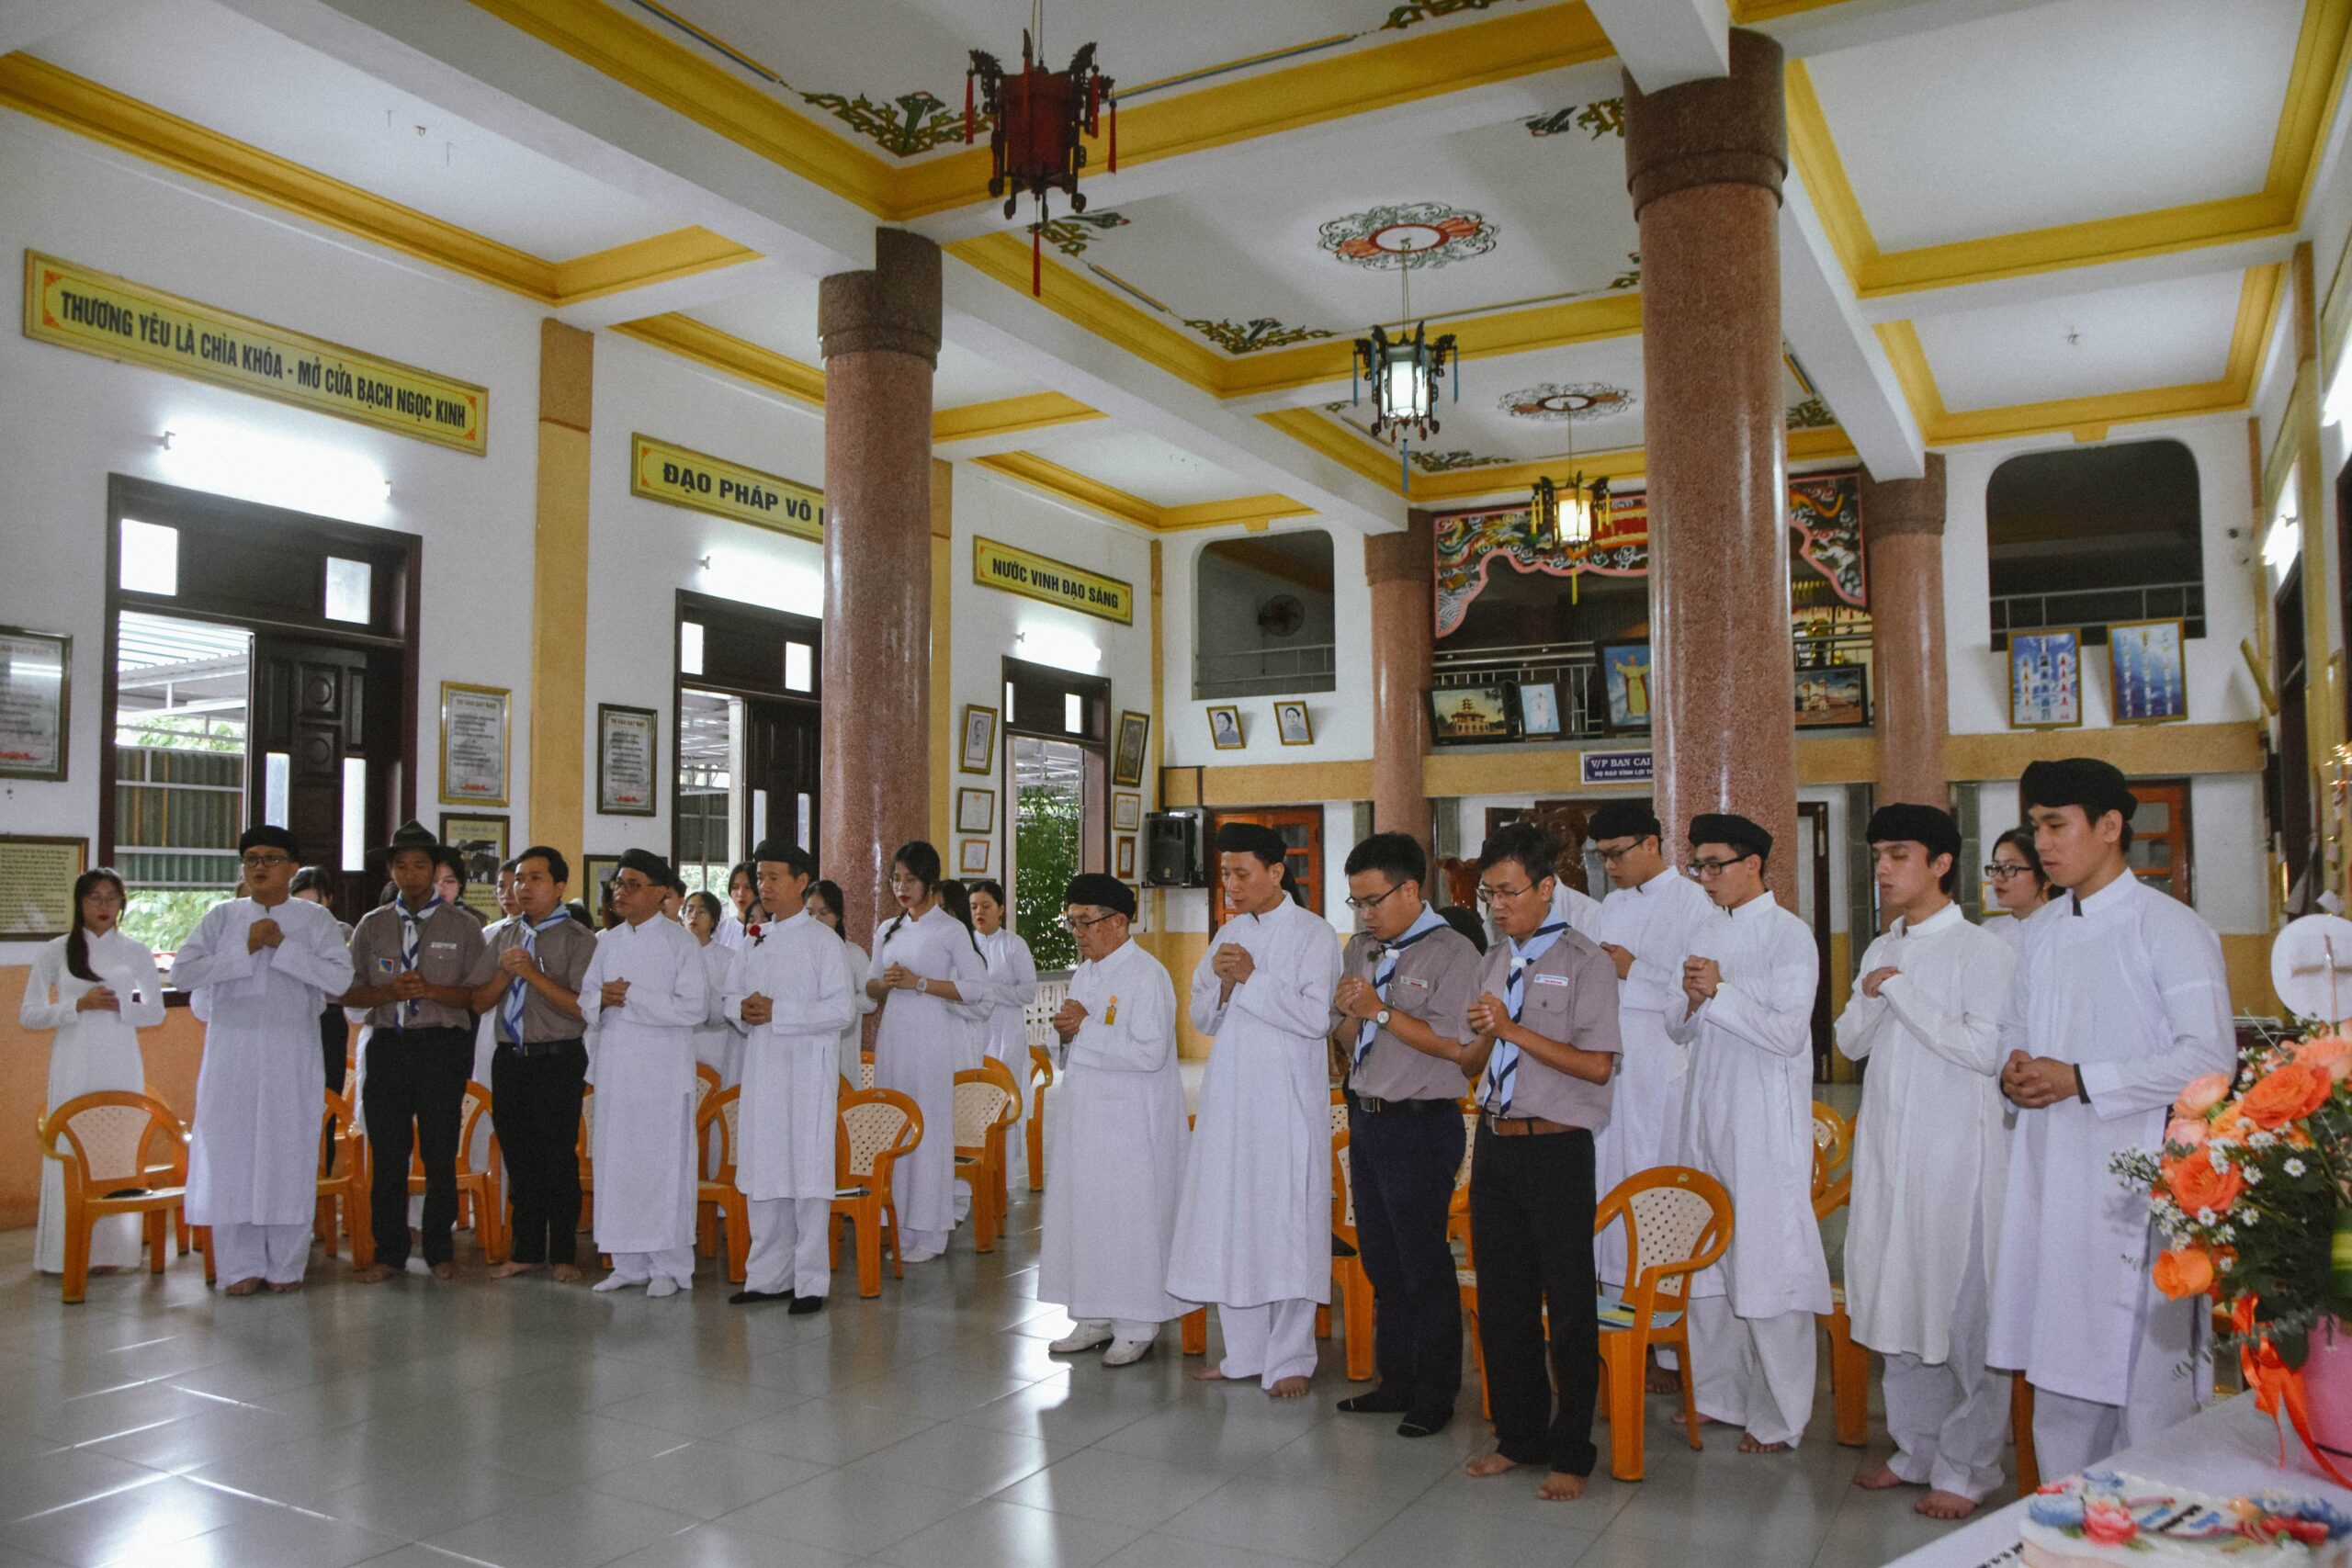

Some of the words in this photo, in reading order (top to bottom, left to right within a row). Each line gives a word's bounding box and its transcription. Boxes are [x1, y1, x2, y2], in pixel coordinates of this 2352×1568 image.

[61, 290, 133, 336] THƯƠNG
[139, 312, 171, 348] YÊU
[175, 323, 196, 355] LÀ
[200, 333, 238, 367] CHÌA
[242, 345, 283, 379] KHÓA
[298, 359, 322, 389] MỞ
[325, 362, 353, 398] CỬA
[357, 376, 393, 409] BẠCH
[396, 388, 433, 422] NGỌC
[435, 397, 466, 428] KINH
[663, 462, 712, 494] ĐẠO
[718, 479, 779, 512] PHÁP
[786, 496, 812, 521] VÔ
[992, 558, 1028, 583] NƯỚC
[1031, 570, 1060, 592] VINH
[1062, 577, 1086, 600] ĐẠO
[1089, 585, 1118, 609] SÁNG
[1591, 760, 1608, 769] V/P
[1634, 758, 1650, 766] CAI
